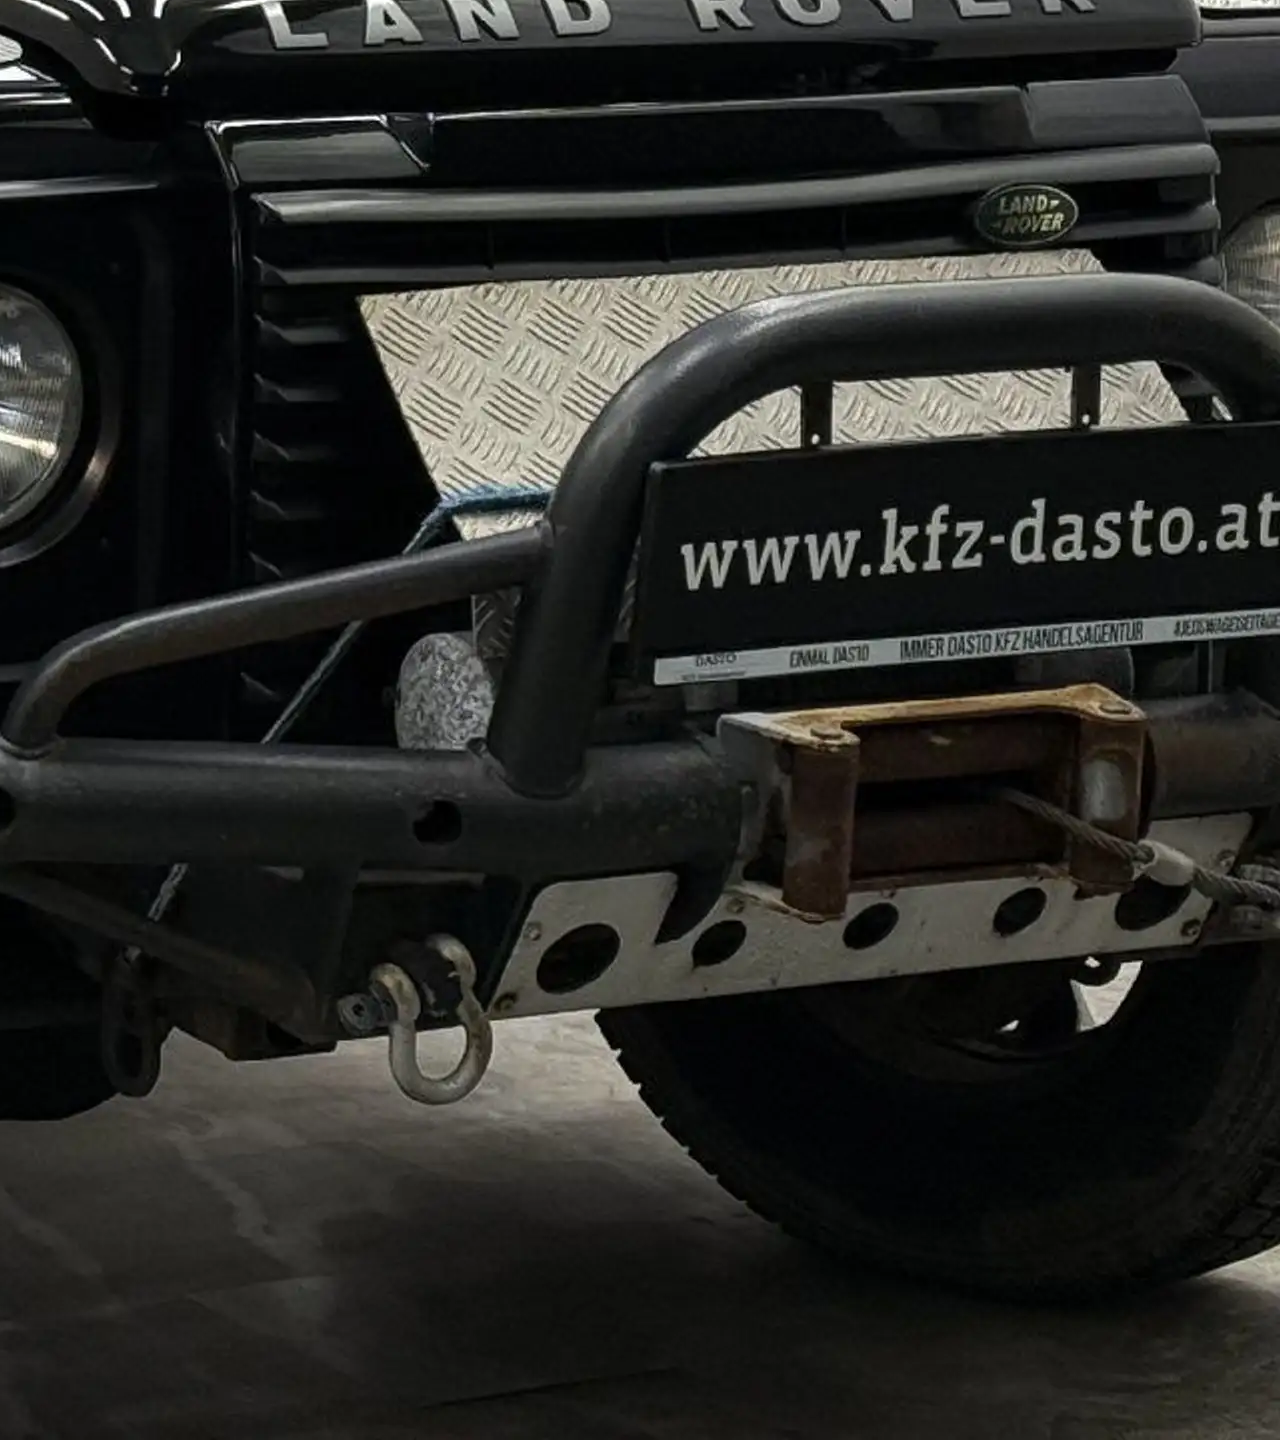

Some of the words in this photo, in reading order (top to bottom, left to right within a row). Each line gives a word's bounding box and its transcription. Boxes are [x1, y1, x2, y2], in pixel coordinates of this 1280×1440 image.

[680, 491, 1280, 592] www.kfz-dasto.at
[900, 635, 944, 660] IMMER
[947, 629, 991, 656] DASTO
[993, 629, 1021, 652] KFZ
[1021, 619, 1144, 649] HANDELSAGENTUR
